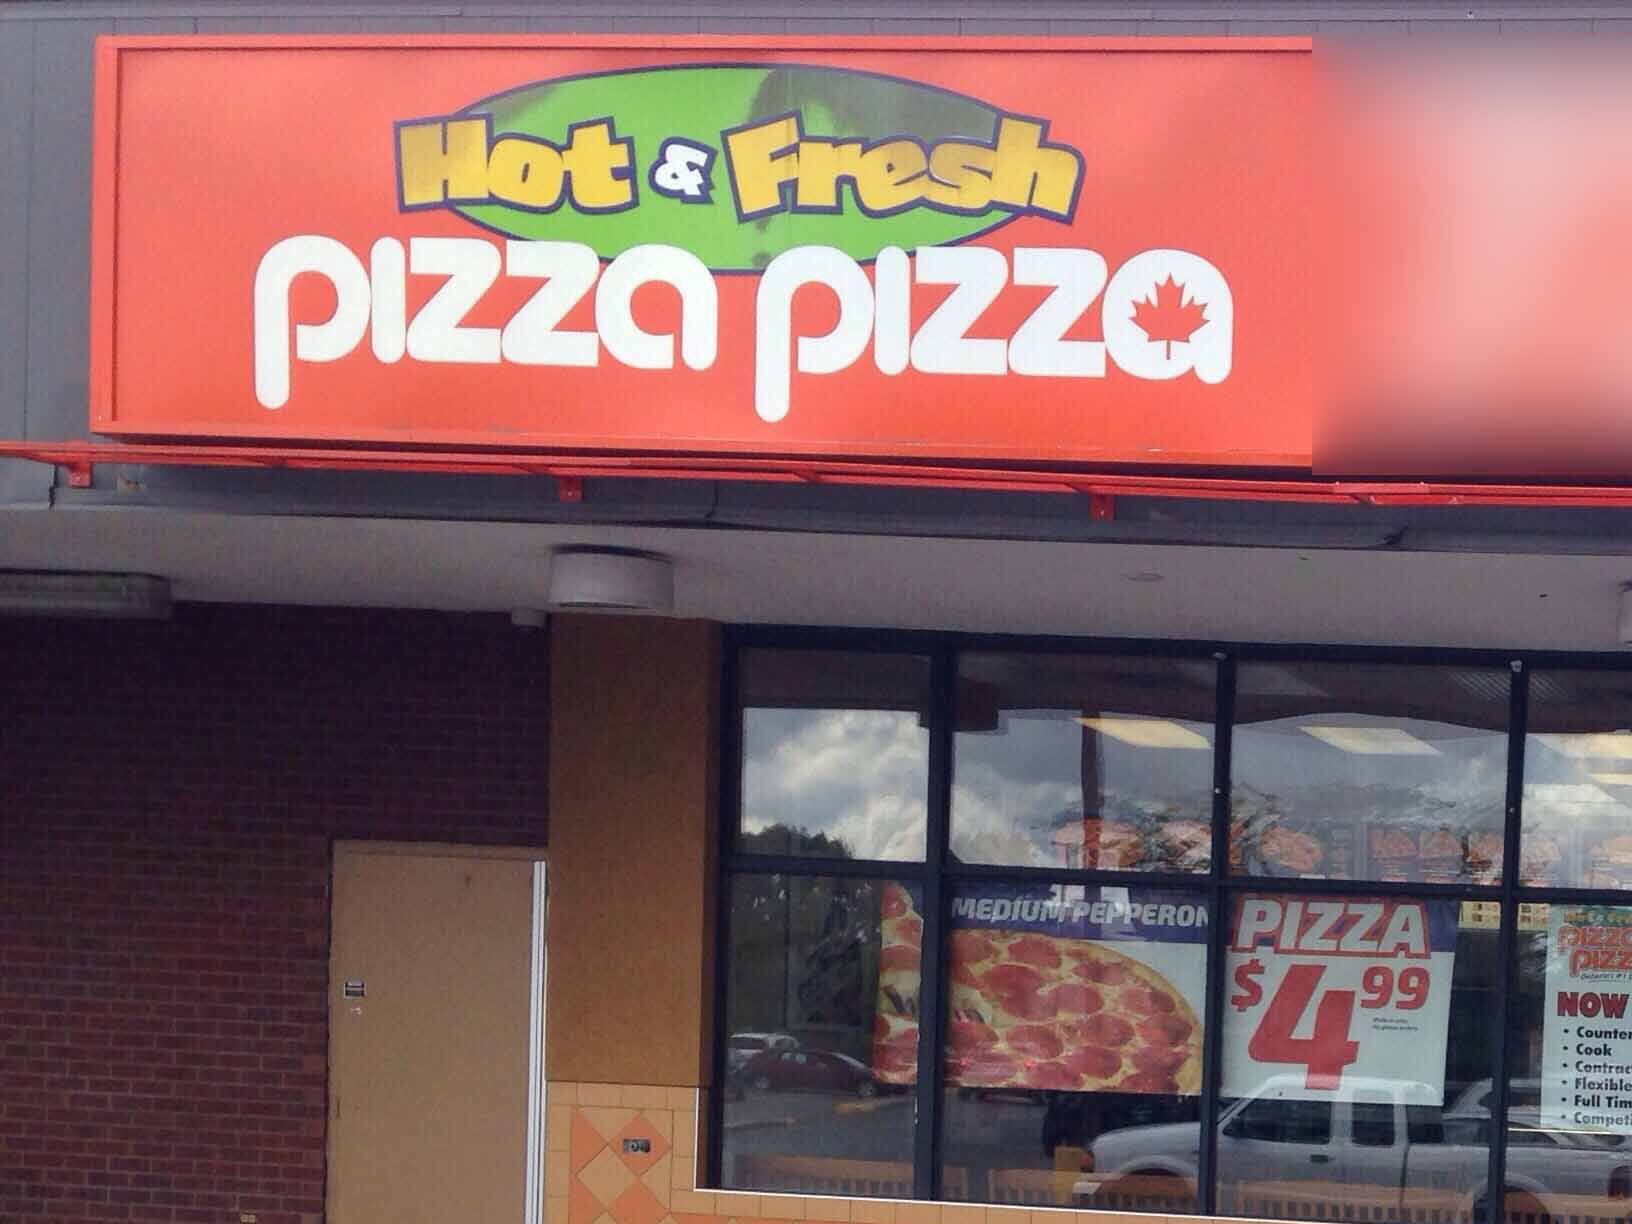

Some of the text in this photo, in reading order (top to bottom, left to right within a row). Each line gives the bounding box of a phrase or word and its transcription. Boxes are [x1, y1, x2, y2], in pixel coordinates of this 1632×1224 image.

[400, 113, 1079, 217] Hot & Fresh
[254, 234, 719, 411] pizza
[754, 244, 1233, 424] pizza
[951, 896, 1208, 928] MEDIUM PEPPERON
[1234, 898, 1428, 955] PIZZA
[1557, 991, 1629, 1018] NOW
[1576, 1043, 1612, 1057] Cook
[1574, 1078, 1632, 1092] Flexible
[1574, 1094, 1602, 1108] Full
